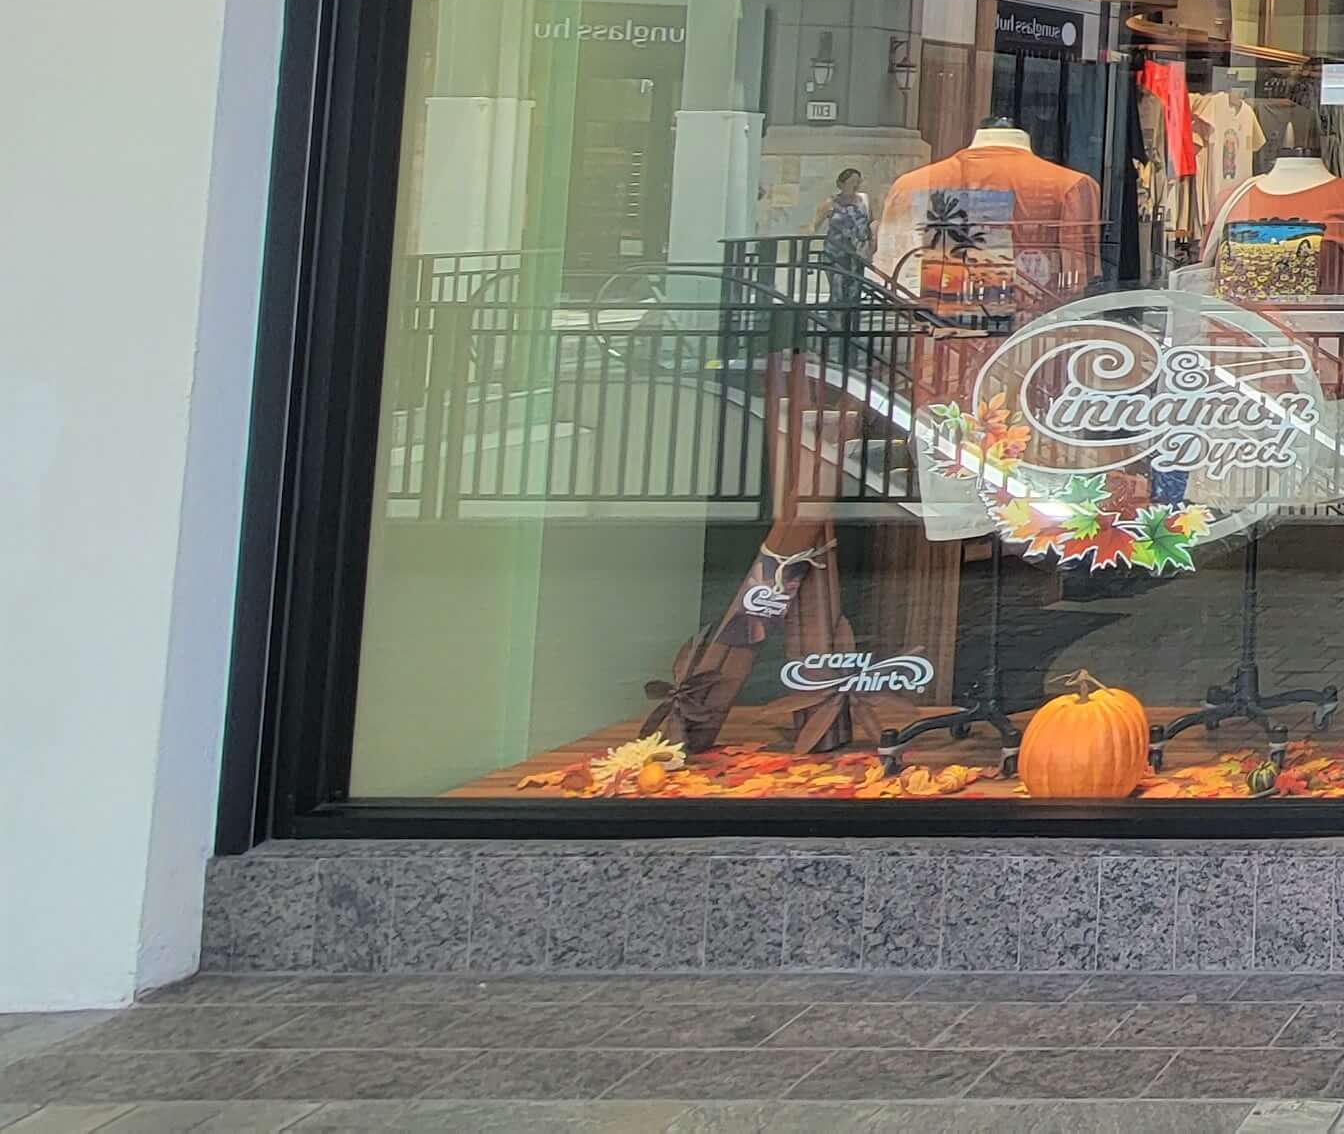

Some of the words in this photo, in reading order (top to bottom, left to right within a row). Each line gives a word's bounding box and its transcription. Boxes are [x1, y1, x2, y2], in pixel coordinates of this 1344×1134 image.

[1151, 427, 1299, 481] Dyed
[803, 652, 872, 672] crazy
[838, 672, 916, 692] shirts
